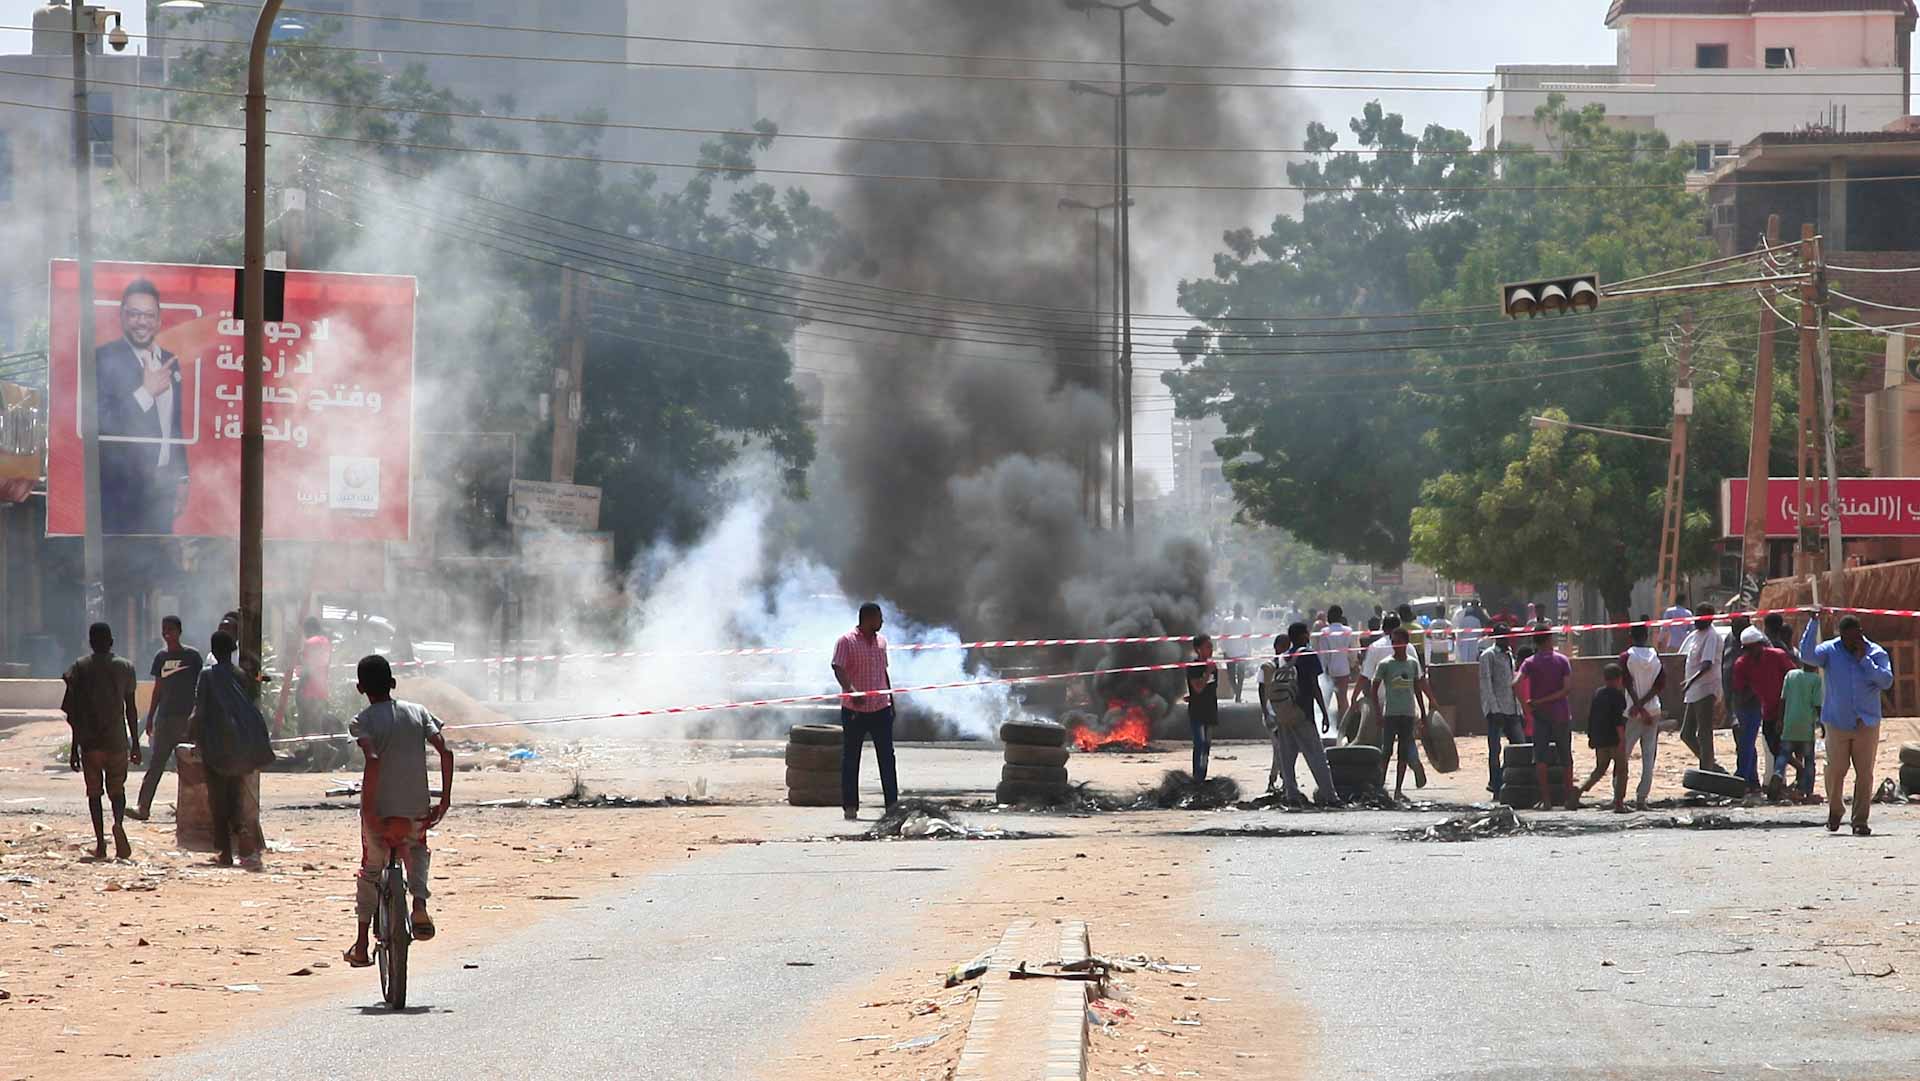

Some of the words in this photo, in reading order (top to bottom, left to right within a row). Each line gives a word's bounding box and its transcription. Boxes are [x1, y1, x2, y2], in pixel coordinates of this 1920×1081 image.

[309, 317, 329, 341] لا
[293, 351, 313, 374] لا
[215, 384, 298, 408] حسب
[307, 383, 383, 414] وفتح
[214, 413, 309, 448] ولخة!
